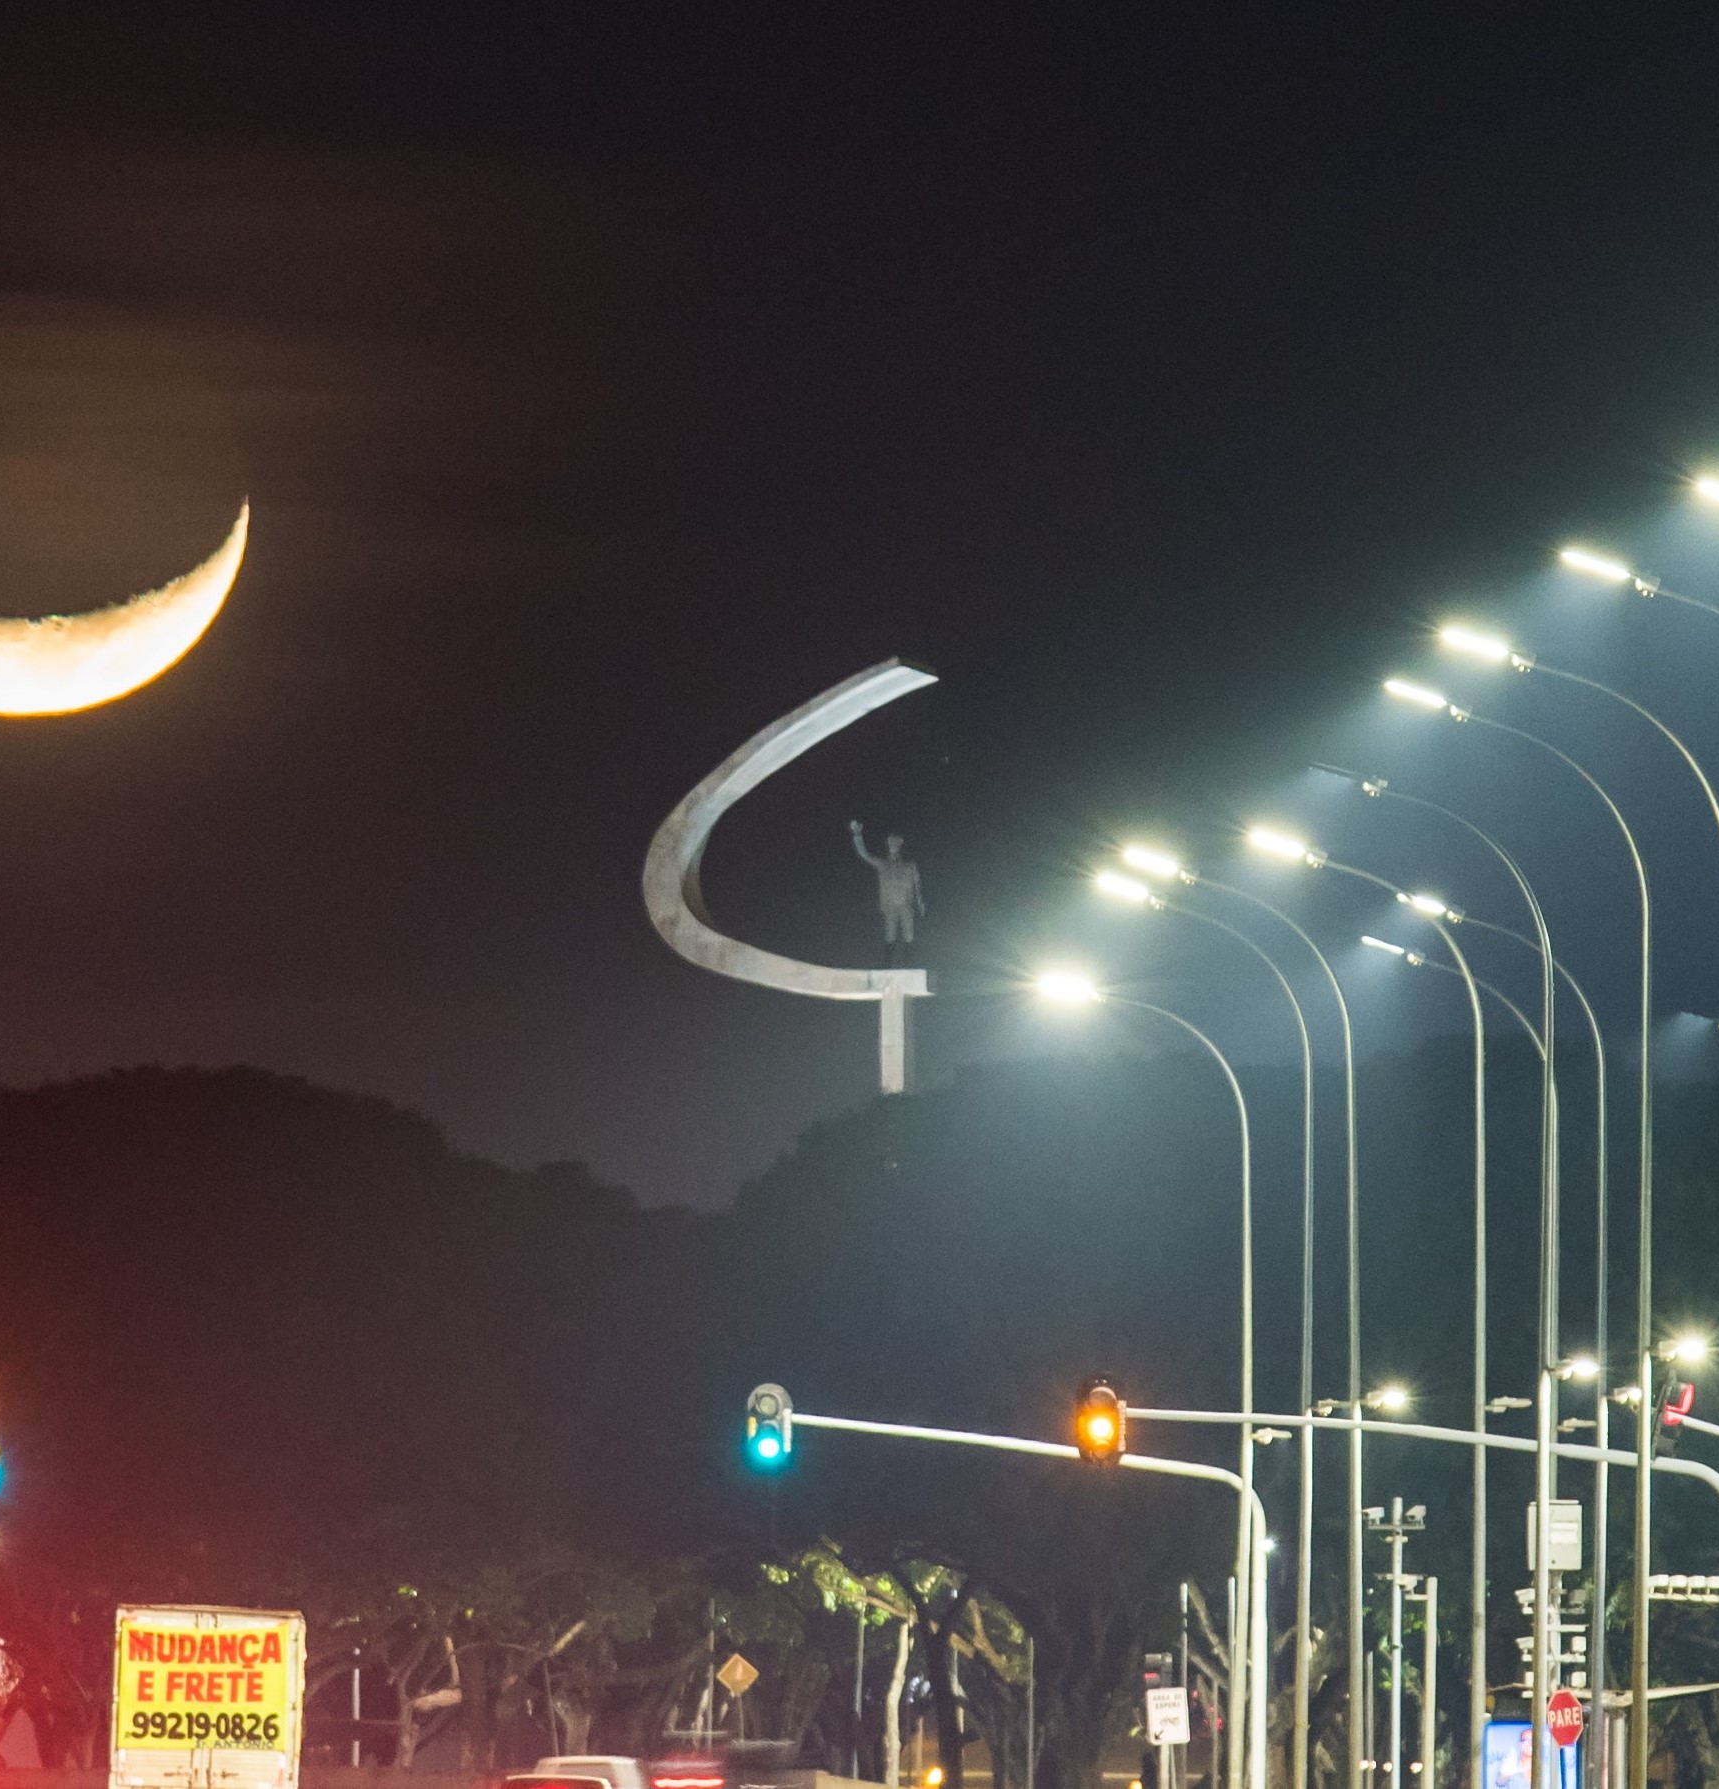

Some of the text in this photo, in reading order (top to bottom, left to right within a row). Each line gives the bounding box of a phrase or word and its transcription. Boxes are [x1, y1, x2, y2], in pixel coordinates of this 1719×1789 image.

[128, 1630, 282, 1669] MUDANÇA
[137, 1671, 263, 1703] E FRETE
[132, 1711, 279, 1741] 99219-0826
[1549, 1706, 1581, 1728] PARE
